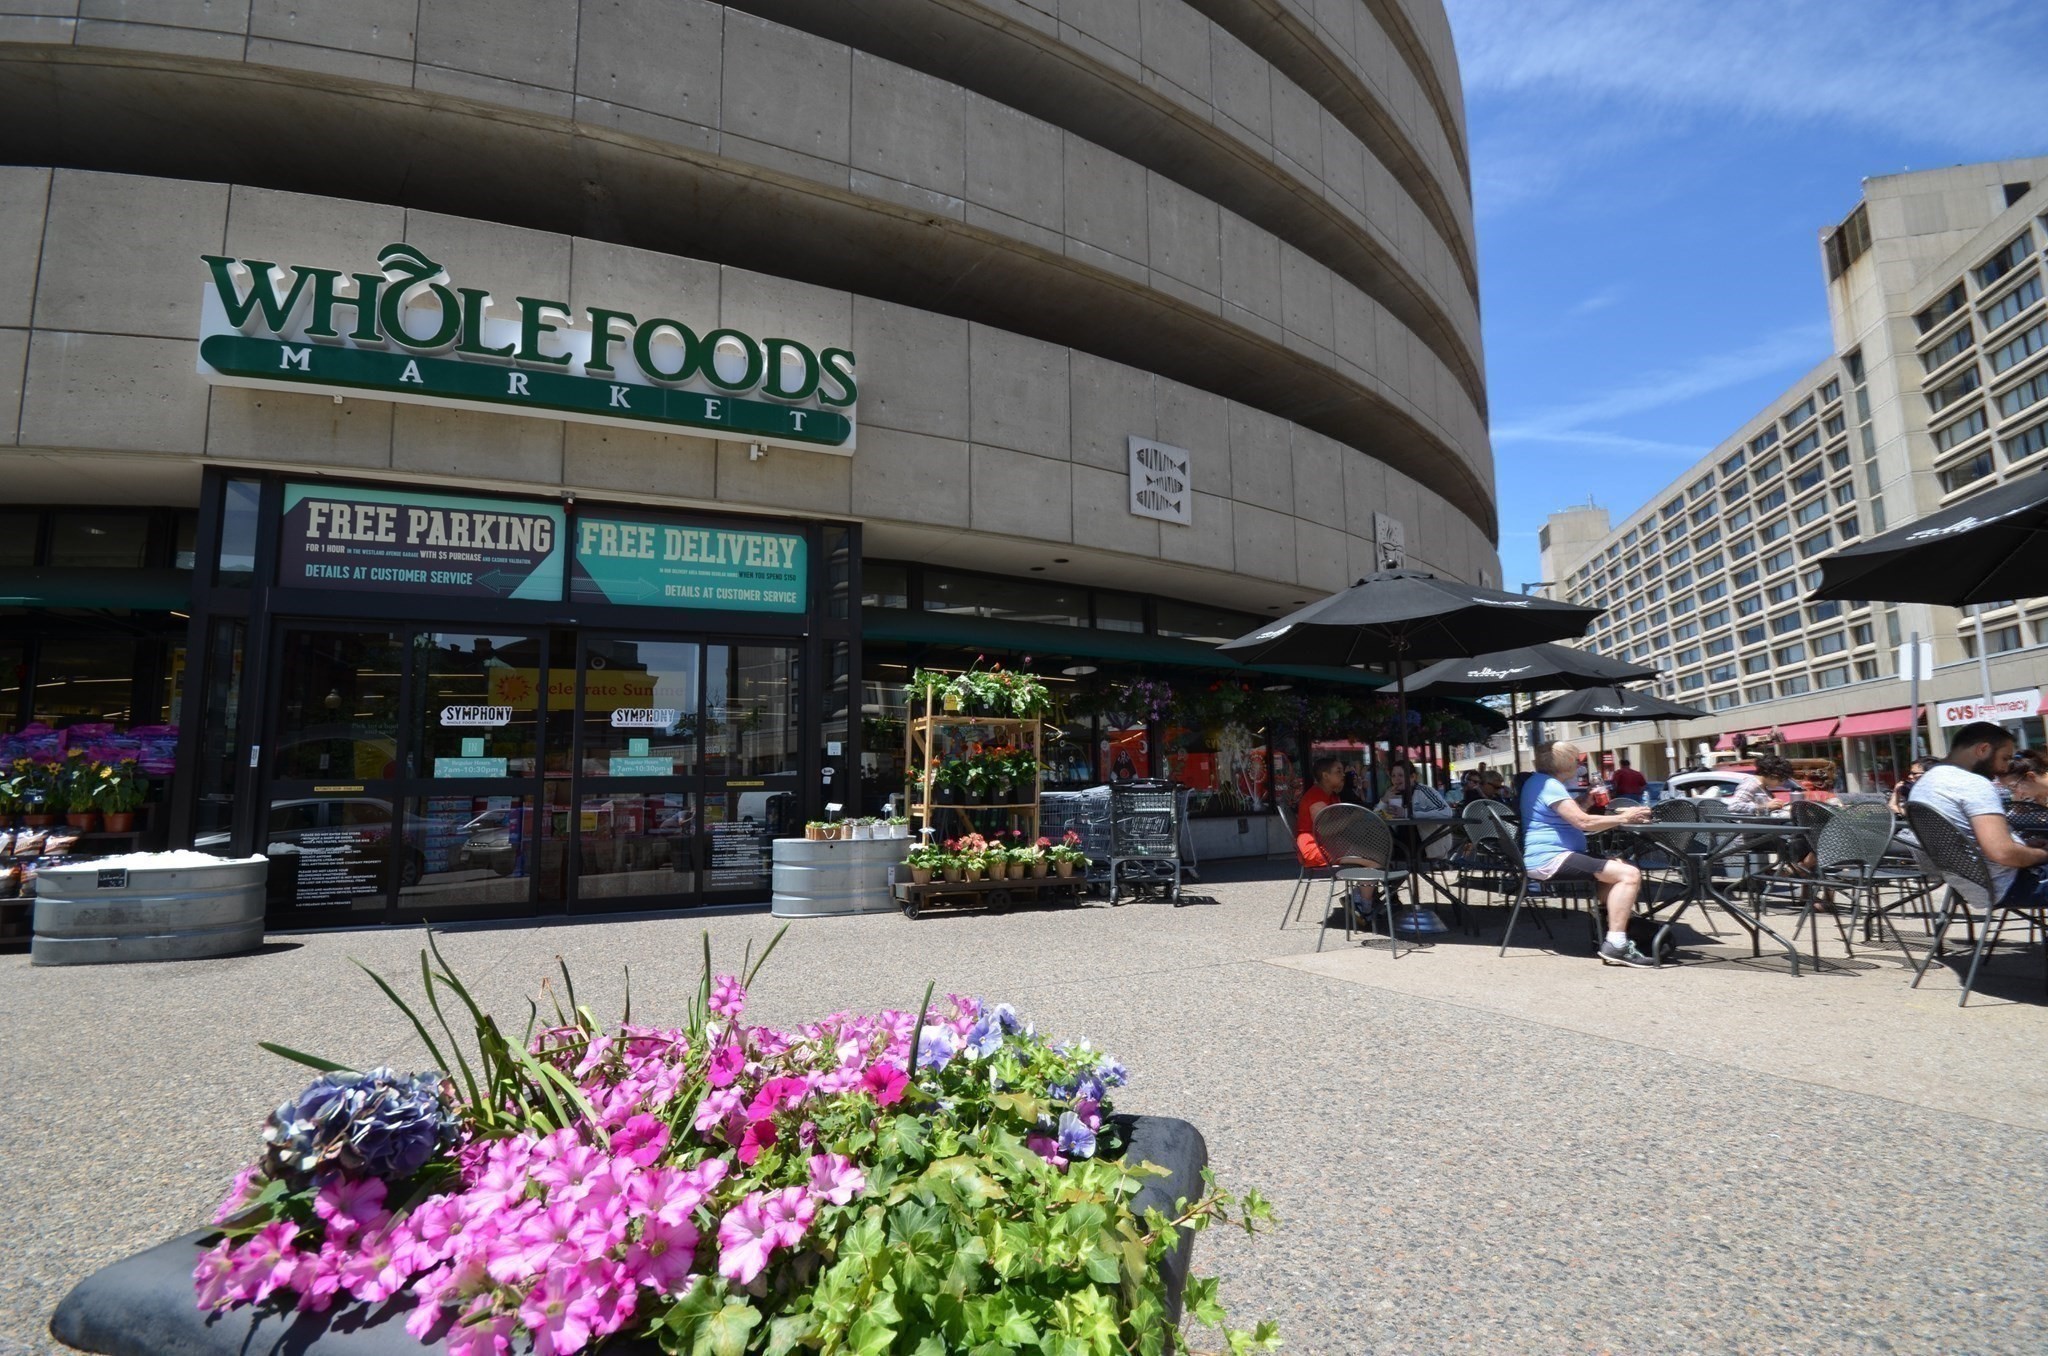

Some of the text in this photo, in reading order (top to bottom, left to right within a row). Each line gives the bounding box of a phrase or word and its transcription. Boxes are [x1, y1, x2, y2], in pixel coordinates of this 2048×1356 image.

[200, 242, 858, 408] WHOLE FOODS
[279, 346, 806, 432] MARKET
[306, 501, 551, 553] FREE PARKING
[305, 543, 319, 552] FOR
[321, 544, 325, 552] 1
[326, 544, 345, 554] HOUR
[419, 550, 437, 559] WITH
[438, 550, 448, 560] $5
[448, 552, 482, 562] PURCHASE
[580, 521, 798, 569] FREE DELIVERY
[305, 564, 473, 585] DETAILS AT CUSTOMER SERVICE
[766, 572, 782, 580] SPEND
[783, 573, 796, 582] $150
[665, 584, 797, 603] DETAILS AT CUSTOMER SERVICE
[446, 707, 512, 720] SYMPHONY
[616, 709, 674, 722] SYMPHONY
[468, 742, 478, 753] IN
[634, 743, 643, 753] IN
[443, 766, 498, 774] 7am-10:30pm
